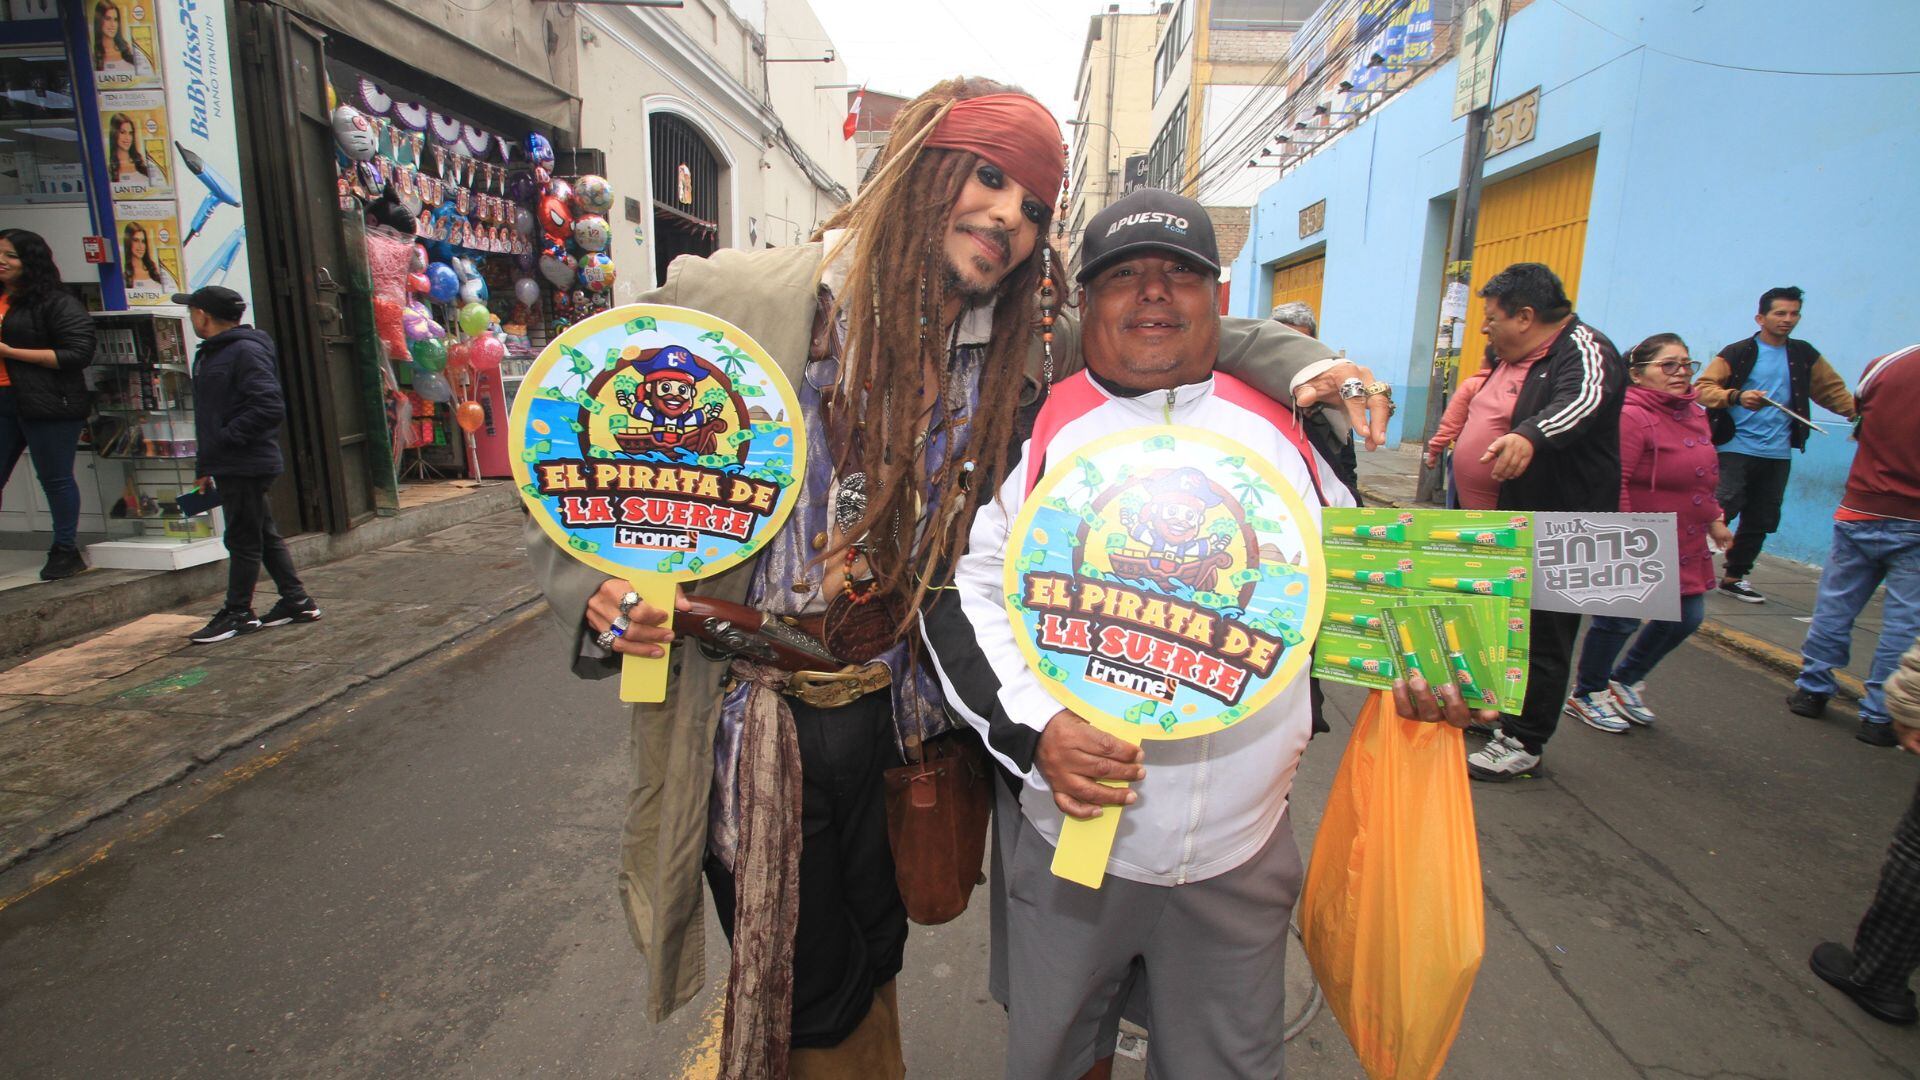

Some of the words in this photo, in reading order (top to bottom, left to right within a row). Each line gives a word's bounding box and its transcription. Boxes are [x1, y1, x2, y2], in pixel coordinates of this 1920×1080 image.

[205, 15, 218, 77] TITANIUM
[210, 79, 221, 118] NANO
[1105, 212, 1189, 238] APUESTO
[542, 464, 586, 490] EL
[595, 464, 721, 499] PIRATA
[731, 477, 777, 510] DE
[564, 497, 615, 524] LA
[621, 496, 753, 538] SUERTE
[1544, 518, 1588, 536] YIMI
[619, 527, 690, 549] trome
[1537, 528, 1659, 567] GLUE
[1545, 560, 1666, 591] SUPER
[1031, 576, 1072, 609] EL
[1080, 585, 1215, 647] PIRATA
[1221, 623, 1278, 671] DE
[1042, 614, 1092, 651] LA
[1098, 625, 1247, 700] SUERTE
[1091, 660, 1167, 698] trome
